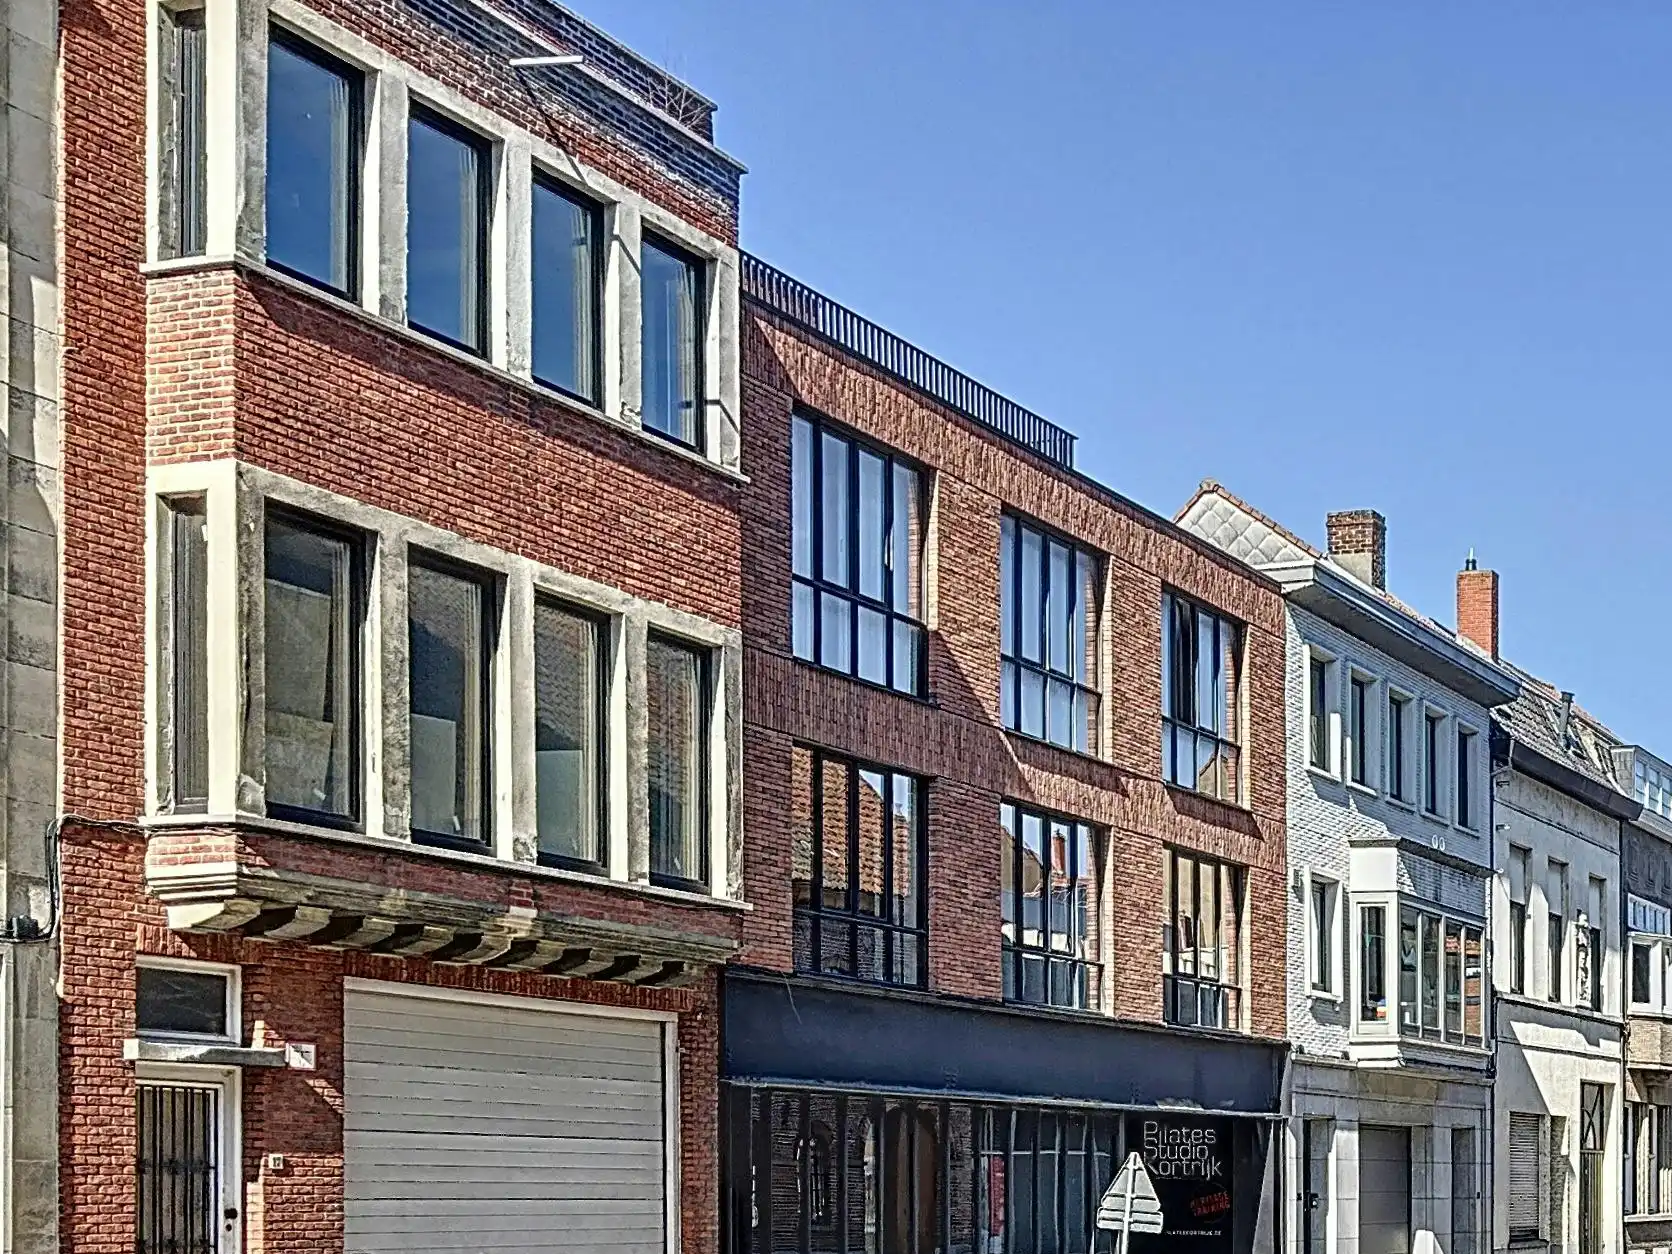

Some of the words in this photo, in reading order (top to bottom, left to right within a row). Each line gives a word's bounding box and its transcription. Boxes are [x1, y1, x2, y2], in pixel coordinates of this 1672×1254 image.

[1144, 1121, 1216, 1144] Pilates
[1144, 1138, 1208, 1160] Studio
[1144, 1152, 1222, 1180] Kortrijk
